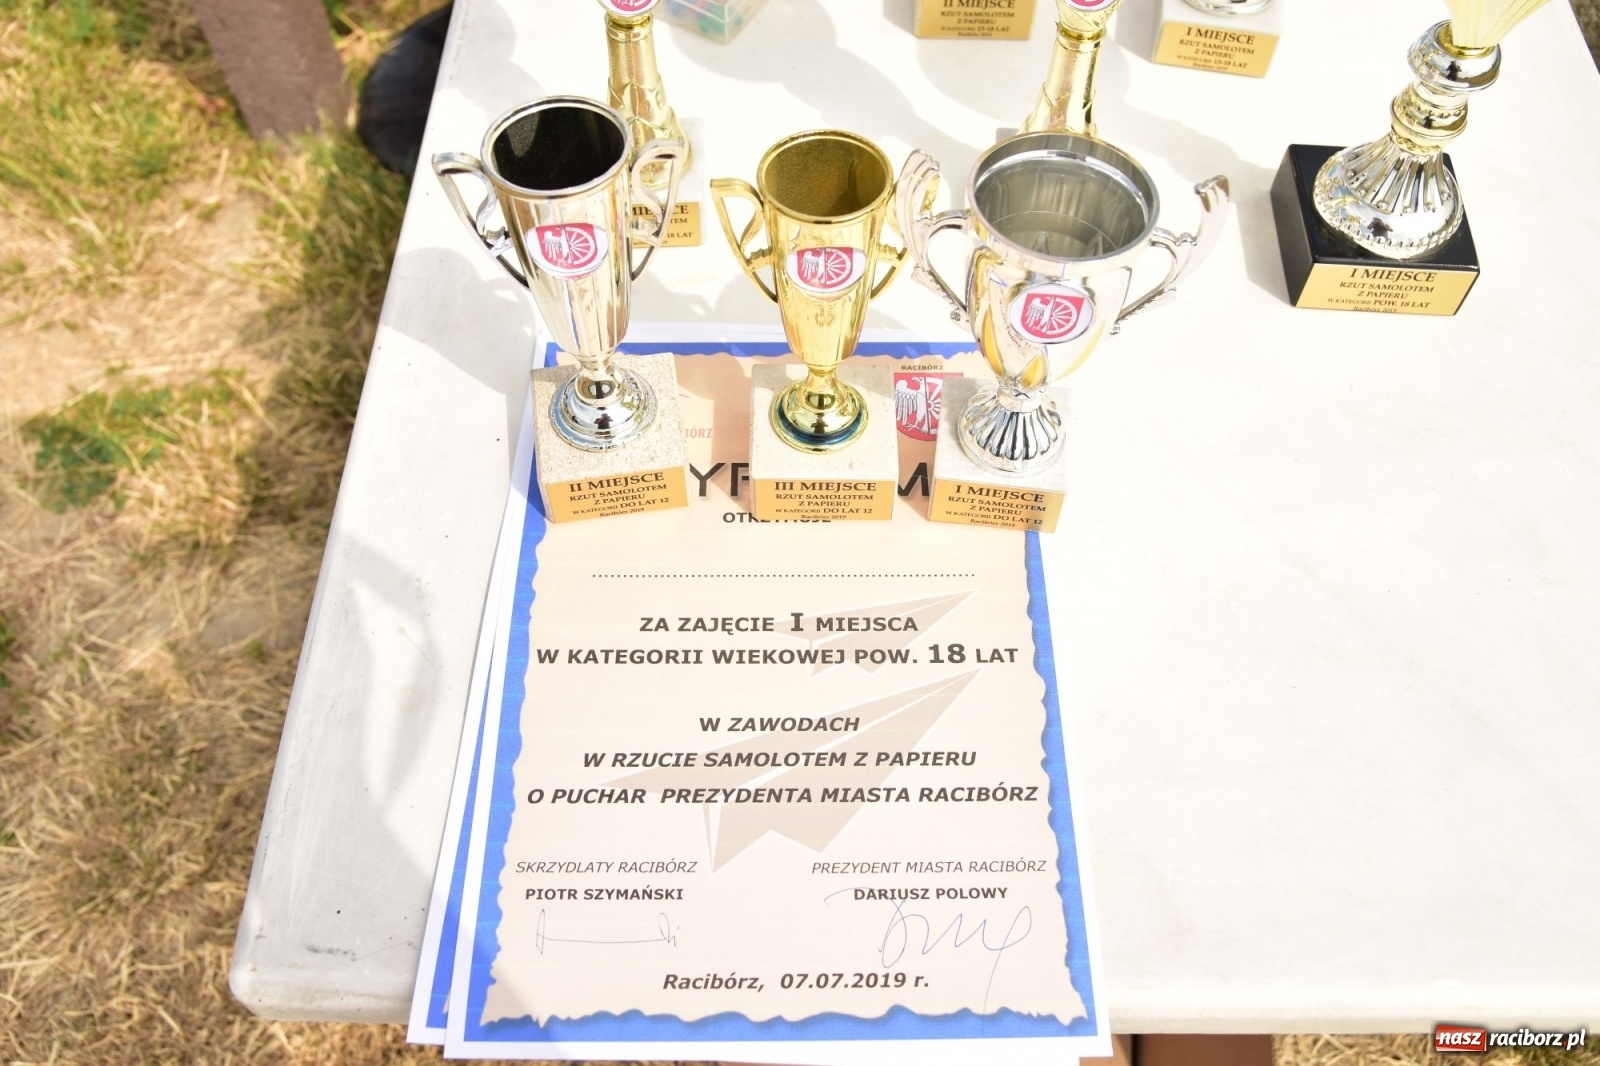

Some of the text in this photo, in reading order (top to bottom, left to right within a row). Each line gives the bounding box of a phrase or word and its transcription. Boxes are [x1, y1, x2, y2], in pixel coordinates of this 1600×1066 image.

[958, 0, 1015, 10] MIEJSCE
[1186, 27, 1255, 44] I MIEJSCE
[1179, 39, 1254, 54] RZUT SAMOLOTEM
[1201, 49, 1235, 60] PAPIERU
[1232, 61, 1248, 69] LAT
[1350, 268, 1438, 282] I MIEJSCE
[1366, 290, 1409, 300] PAPIERU
[1368, 282, 1434, 293] SAMOLOTEM
[569, 472, 664, 492] II MIEJSCE
[774, 482, 877, 493] III MIEJSCE
[569, 484, 666, 502] RZUT SAMOLOTEM
[603, 494, 646, 504] PAPIERU
[955, 484, 1044, 502] I MIEJSCE
[948, 496, 1046, 512] RZUT SAMOLOTEM
[978, 506, 1022, 516] PAPIERU
[640, 612, 918, 636] ZA ZAJĘCIE I MIEJSCA
[537, 644, 1018, 664] W KATEGORII WIEKOWEJ POW. 18 LAT
[700, 717, 860, 732] W ZAWODACH
[584, 752, 976, 767] W RZUCIE SAMOLOTEM Z PAPIERU
[527, 782, 1038, 804] O PUCHAR PREZYDENTA MIASTA RACIBÓRZ
[515, 858, 698, 873] SKRZYDLATY RACIBÓRZ
[812, 856, 1047, 874] PREZYDENT MIASTA RACIBÓRZ
[525, 885, 684, 900] PIOTR SZYMAŃSKI
[854, 887, 1008, 900] DARIUSZ POLOWY
[662, 972, 930, 993] Racibórz, 07.07.2019 r.
